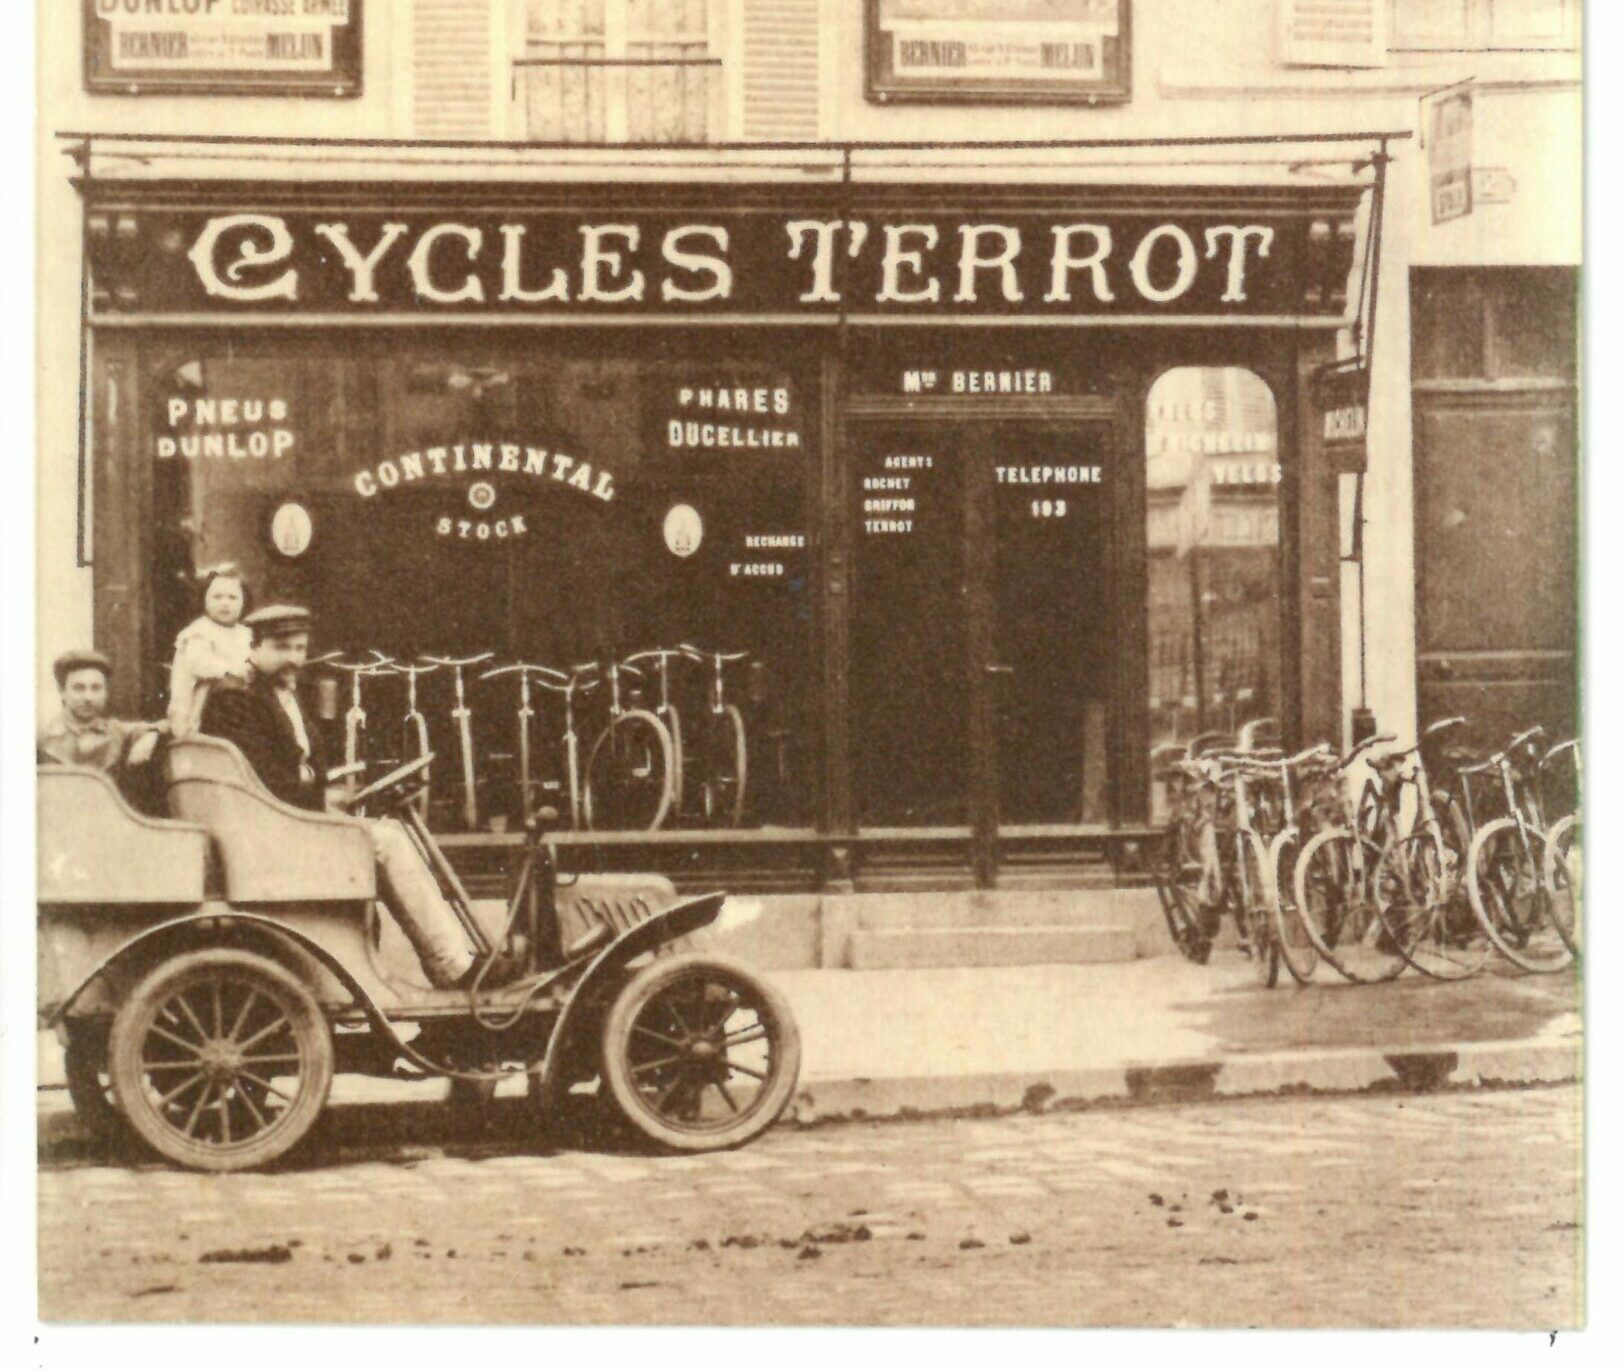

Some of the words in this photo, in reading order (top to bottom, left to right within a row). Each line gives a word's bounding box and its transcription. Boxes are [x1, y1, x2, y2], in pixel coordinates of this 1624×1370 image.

[187, 213, 733, 303] CYCLES
[785, 219, 1275, 303] TERROT
[952, 369, 1052, 393] BERNIER
[167, 398, 287, 426] PNEUS
[679, 387, 790, 415] PHARES
[157, 428, 295, 461] DUNLOP
[668, 419, 799, 447] DUCELLIER
[352, 442, 615, 504] CONTINENTAL
[884, 455, 933, 469] AGENTS
[995, 466, 1101, 484] TELEPHONE
[436, 515, 527, 540] STOCK
